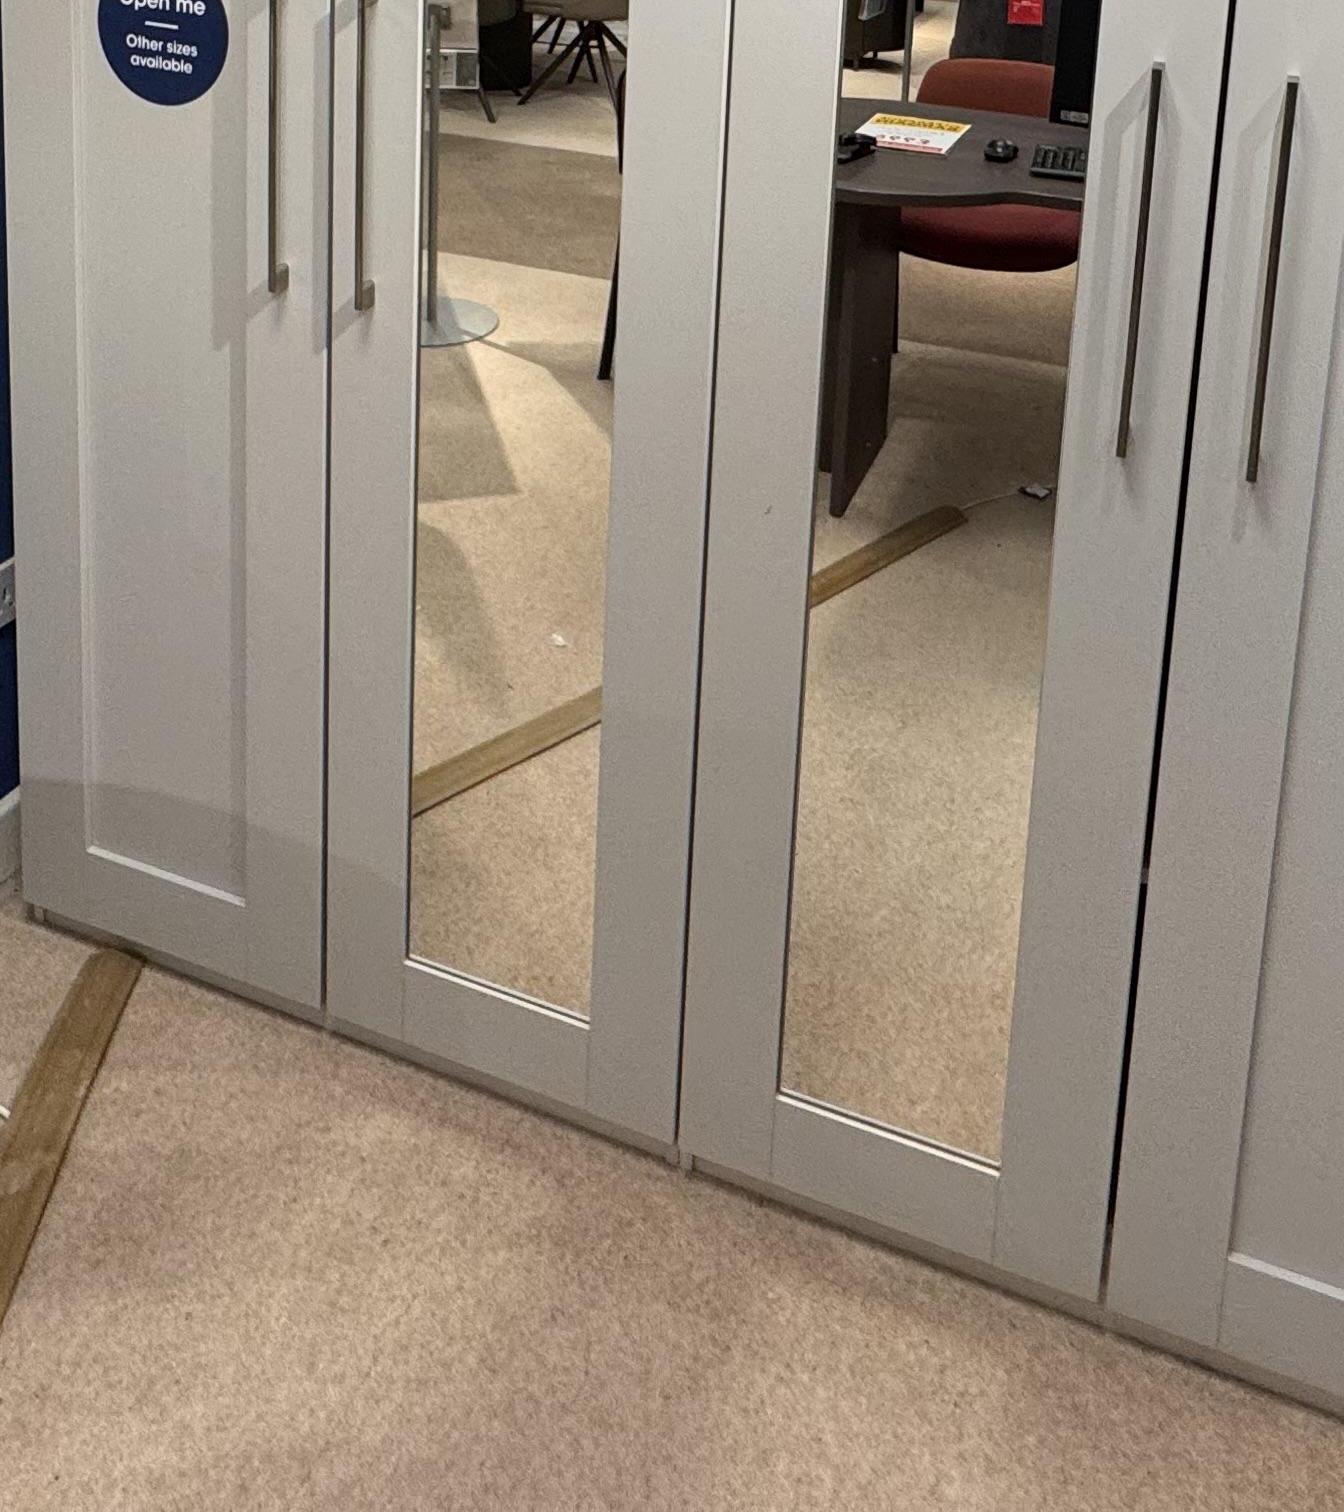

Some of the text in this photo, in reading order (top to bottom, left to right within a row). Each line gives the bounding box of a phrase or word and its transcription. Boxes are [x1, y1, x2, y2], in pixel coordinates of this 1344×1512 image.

[126, 34, 198, 57] Other sizes
[130, 54, 193, 74] available
